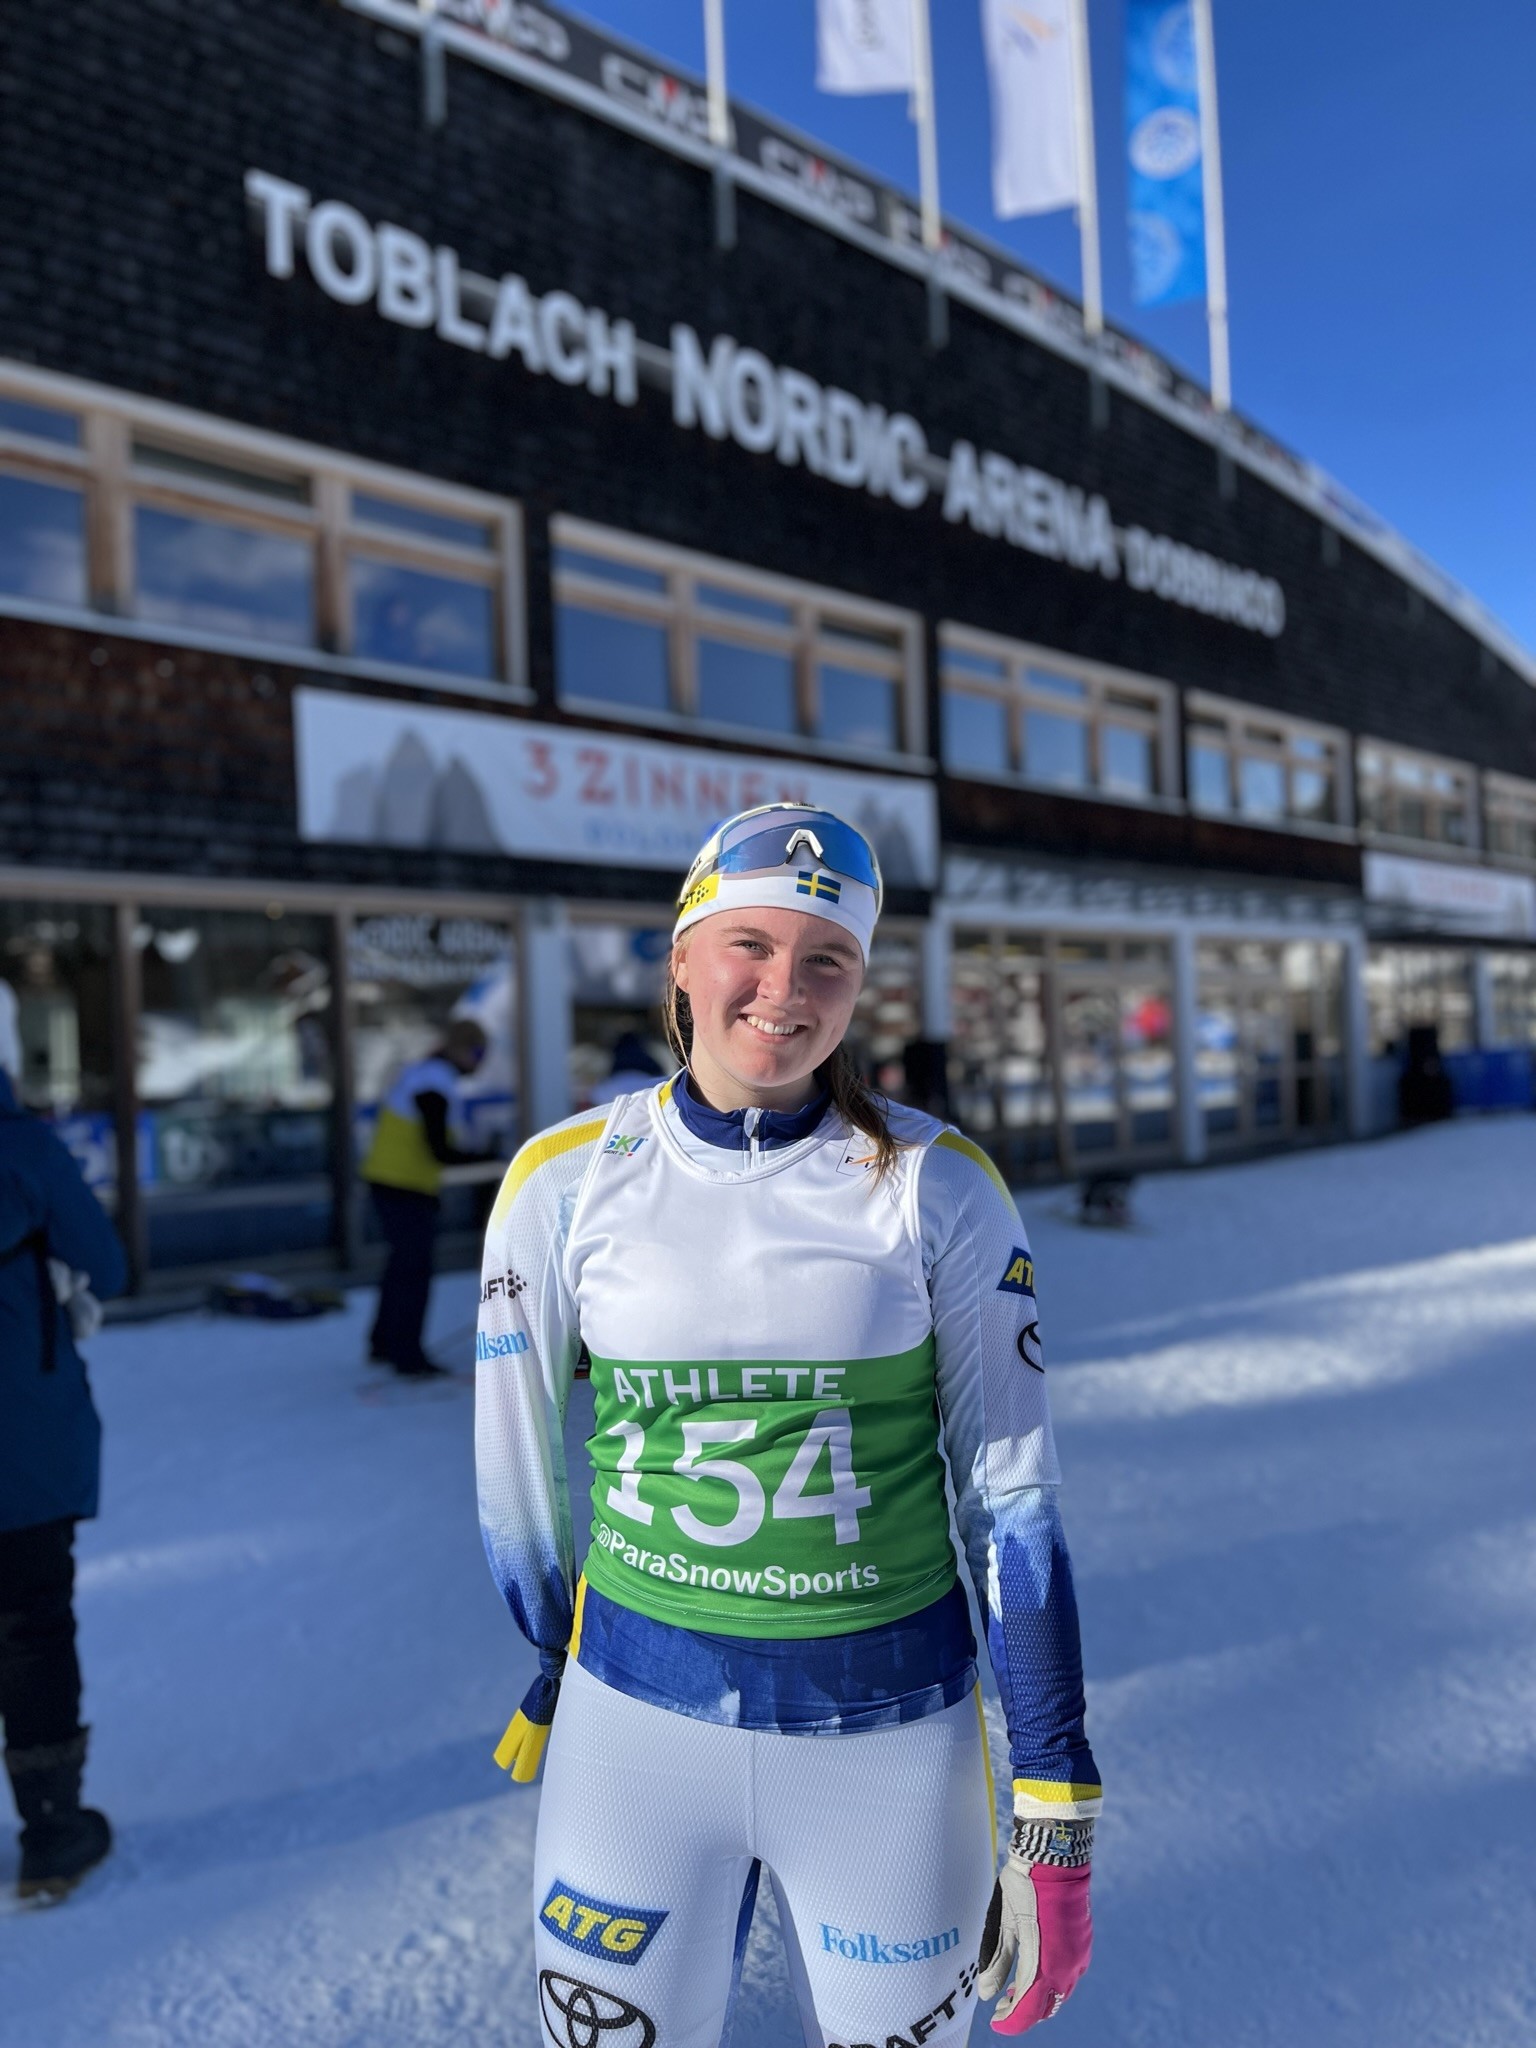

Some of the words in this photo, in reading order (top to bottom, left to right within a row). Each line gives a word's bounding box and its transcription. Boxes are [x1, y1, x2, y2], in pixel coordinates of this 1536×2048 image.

[244, 168, 637, 406] TOBLACH
[670, 321, 929, 509] NORDIC
[942, 438, 1120, 580] ARENA
[525, 741, 557, 797] 3
[1004, 1256, 1034, 1288] AT
[613, 1367, 847, 1408] ATHLETE
[605, 1407, 873, 1547] 154
[597, 1523, 881, 1600] @ParaSnowSports
[543, 1894, 649, 1953] ATG
[818, 1922, 961, 1965] Folksam
